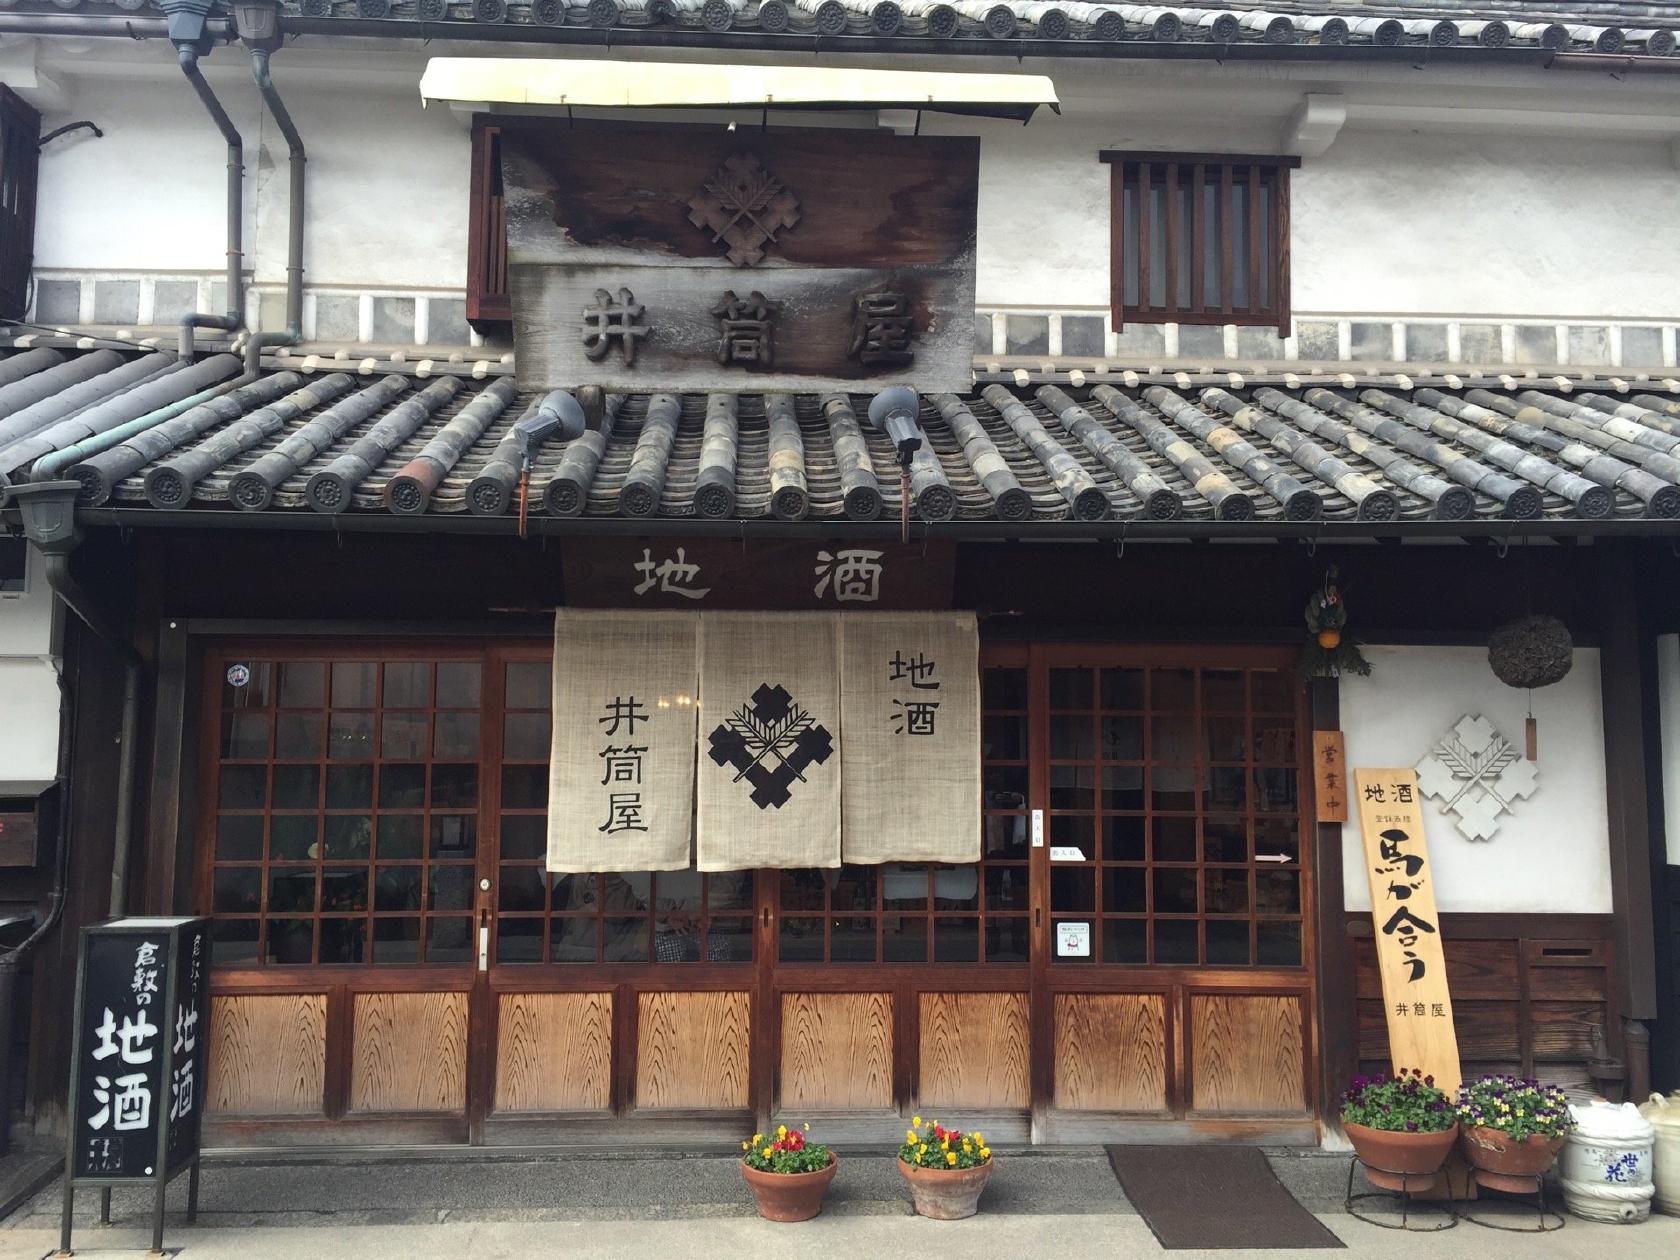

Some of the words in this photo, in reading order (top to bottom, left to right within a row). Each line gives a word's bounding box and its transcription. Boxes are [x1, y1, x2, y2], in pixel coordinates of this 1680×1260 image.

[582, 287, 915, 367] 井筒屋
[633, 547, 885, 601] 地酒
[888, 650, 940, 737] 地酒
[598, 695, 649, 834] 井筒屋
[1321, 744, 1341, 816] 営業中
[1364, 783, 1413, 803] 地酒
[1375, 829, 1436, 984] 馬が合う
[130, 941, 160, 1005] 倉敷の
[1395, 1001, 1446, 1018] 井筒屋
[87, 1006, 159, 1131] 地酒
[170, 998, 198, 1123] 地酒
